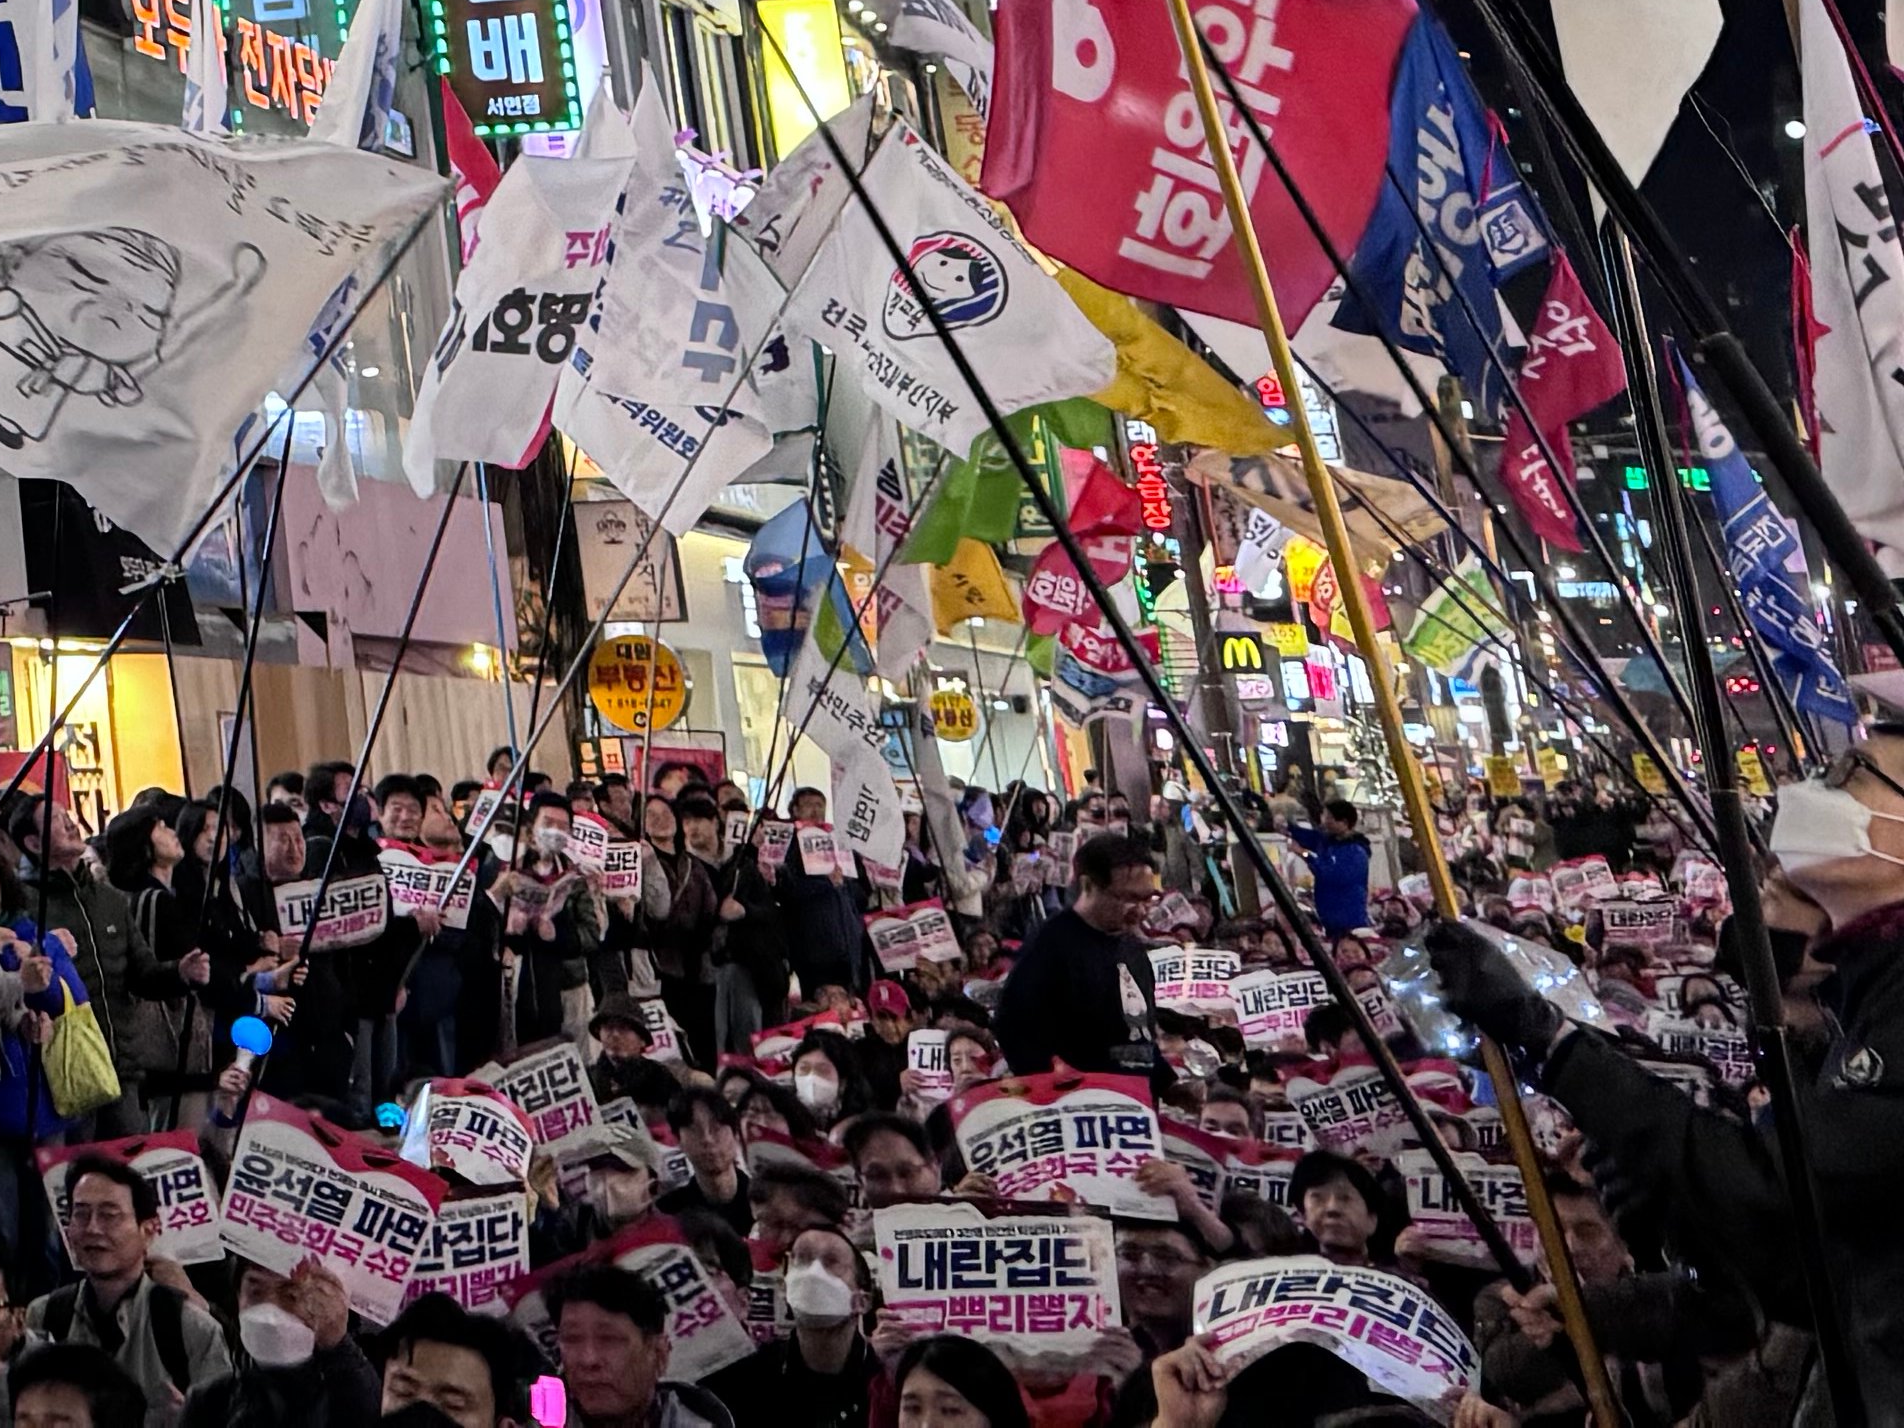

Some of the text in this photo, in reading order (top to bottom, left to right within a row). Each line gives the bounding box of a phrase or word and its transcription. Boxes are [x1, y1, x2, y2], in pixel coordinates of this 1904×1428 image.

[1073, 1114, 1155, 1152] 파면
[231, 1153, 354, 1226] 윤석열
[353, 1198, 430, 1258] 파면
[897, 1237, 1102, 1291] 내란집단
